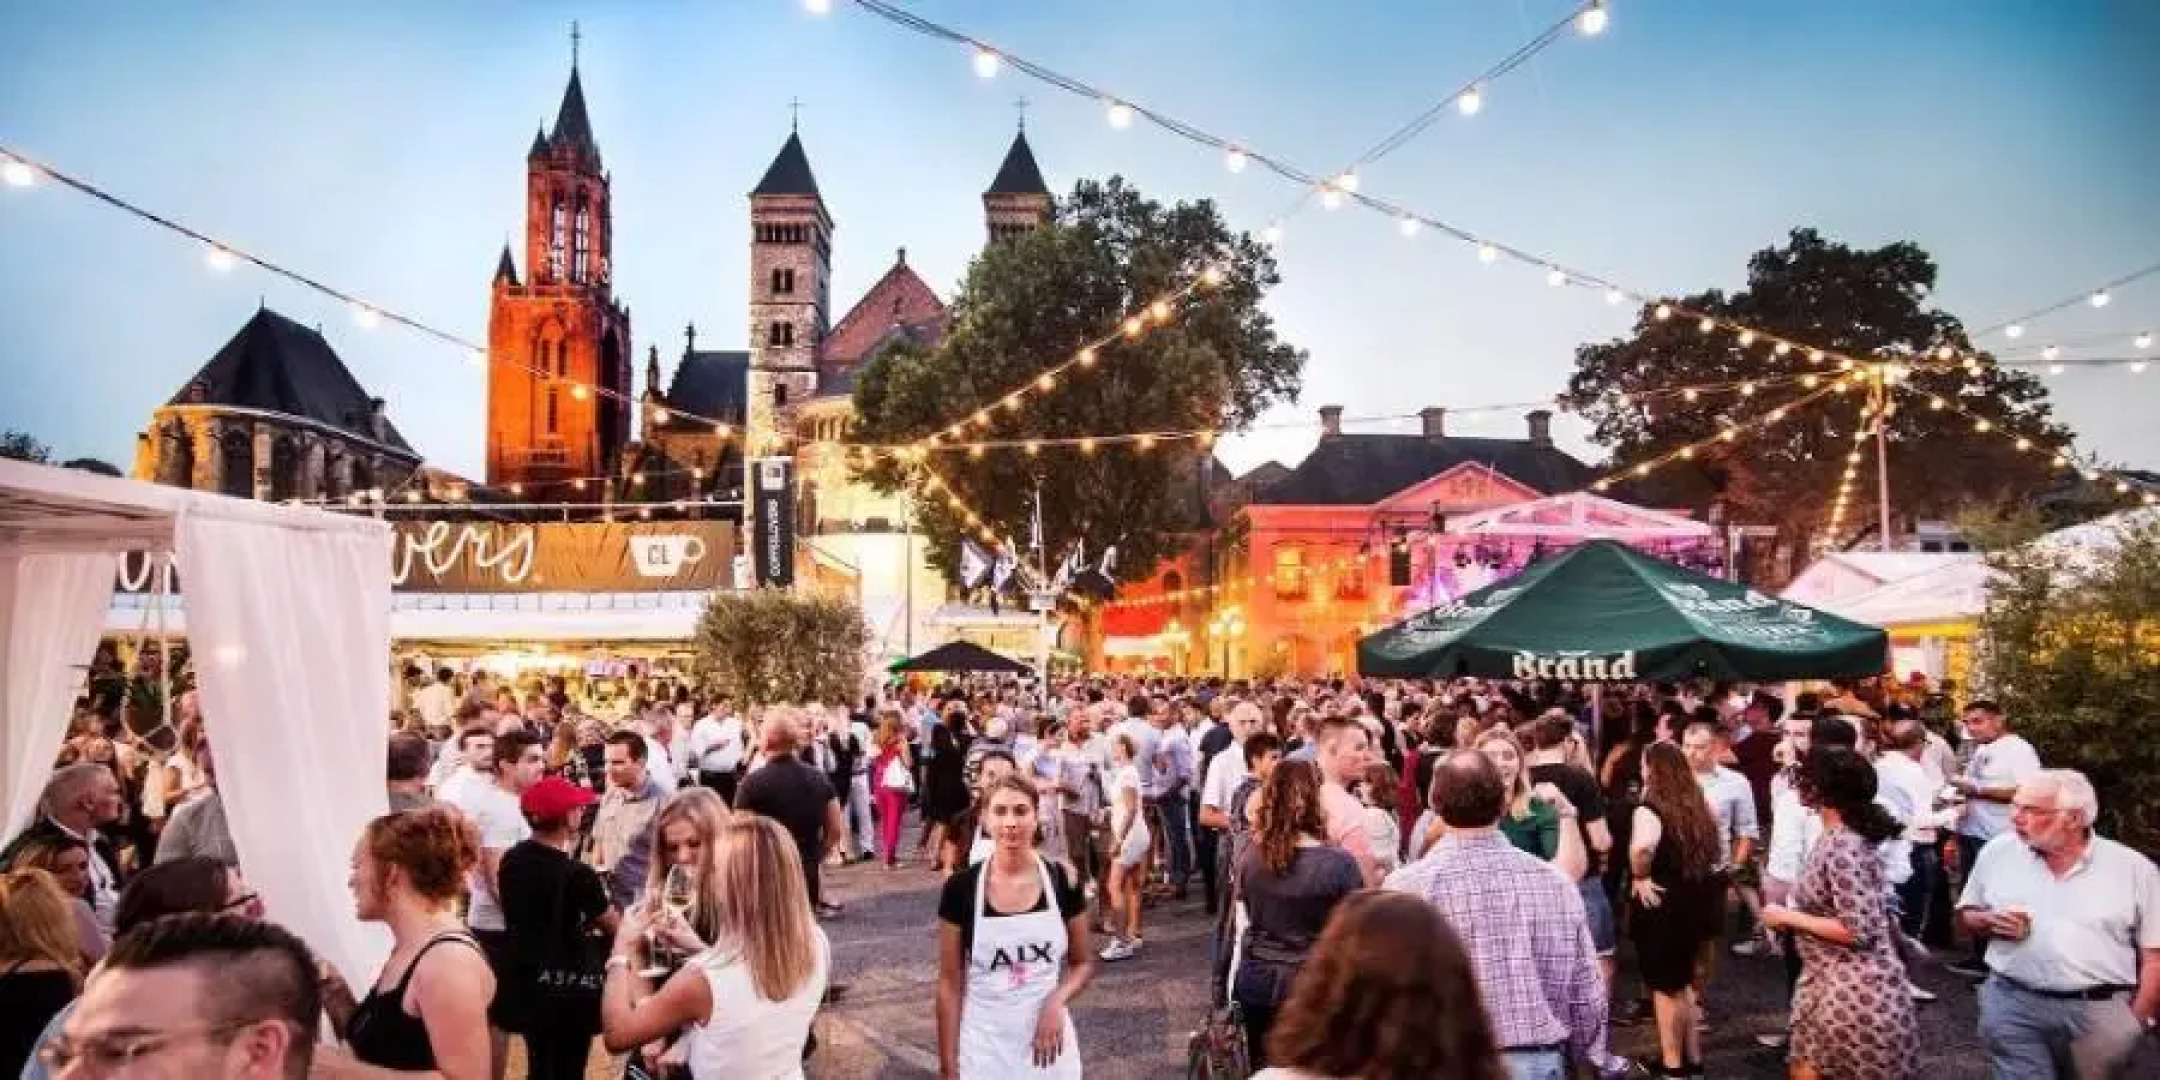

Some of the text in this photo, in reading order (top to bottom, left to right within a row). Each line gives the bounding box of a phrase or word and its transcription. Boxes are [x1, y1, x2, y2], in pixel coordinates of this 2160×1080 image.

[390, 520, 533, 584] vers
[1513, 649, 1638, 680] Brand
[990, 941, 1052, 973] AIX
